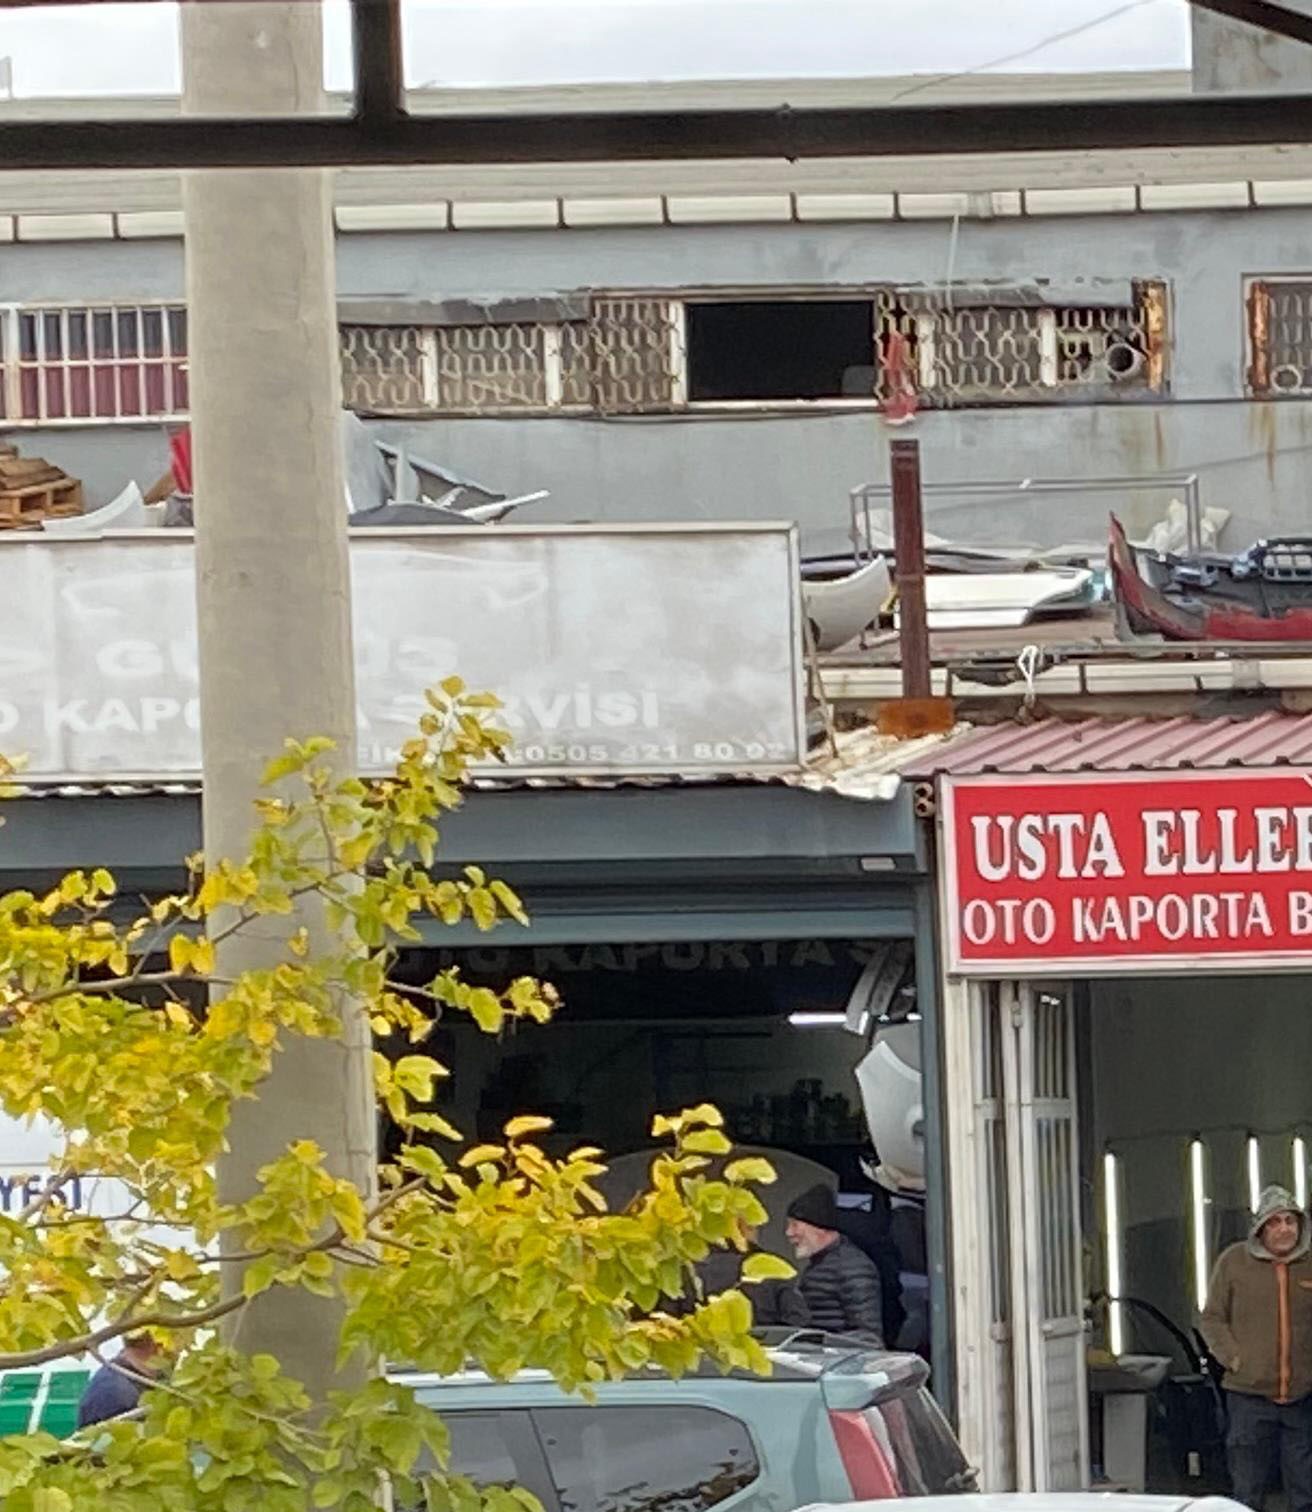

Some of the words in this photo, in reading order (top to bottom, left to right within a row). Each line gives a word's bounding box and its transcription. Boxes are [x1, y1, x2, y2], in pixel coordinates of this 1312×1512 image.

[971, 812, 1125, 880] USTA
[963, 898, 1055, 945] OTO
[1073, 892, 1273, 942] KAPORTA
